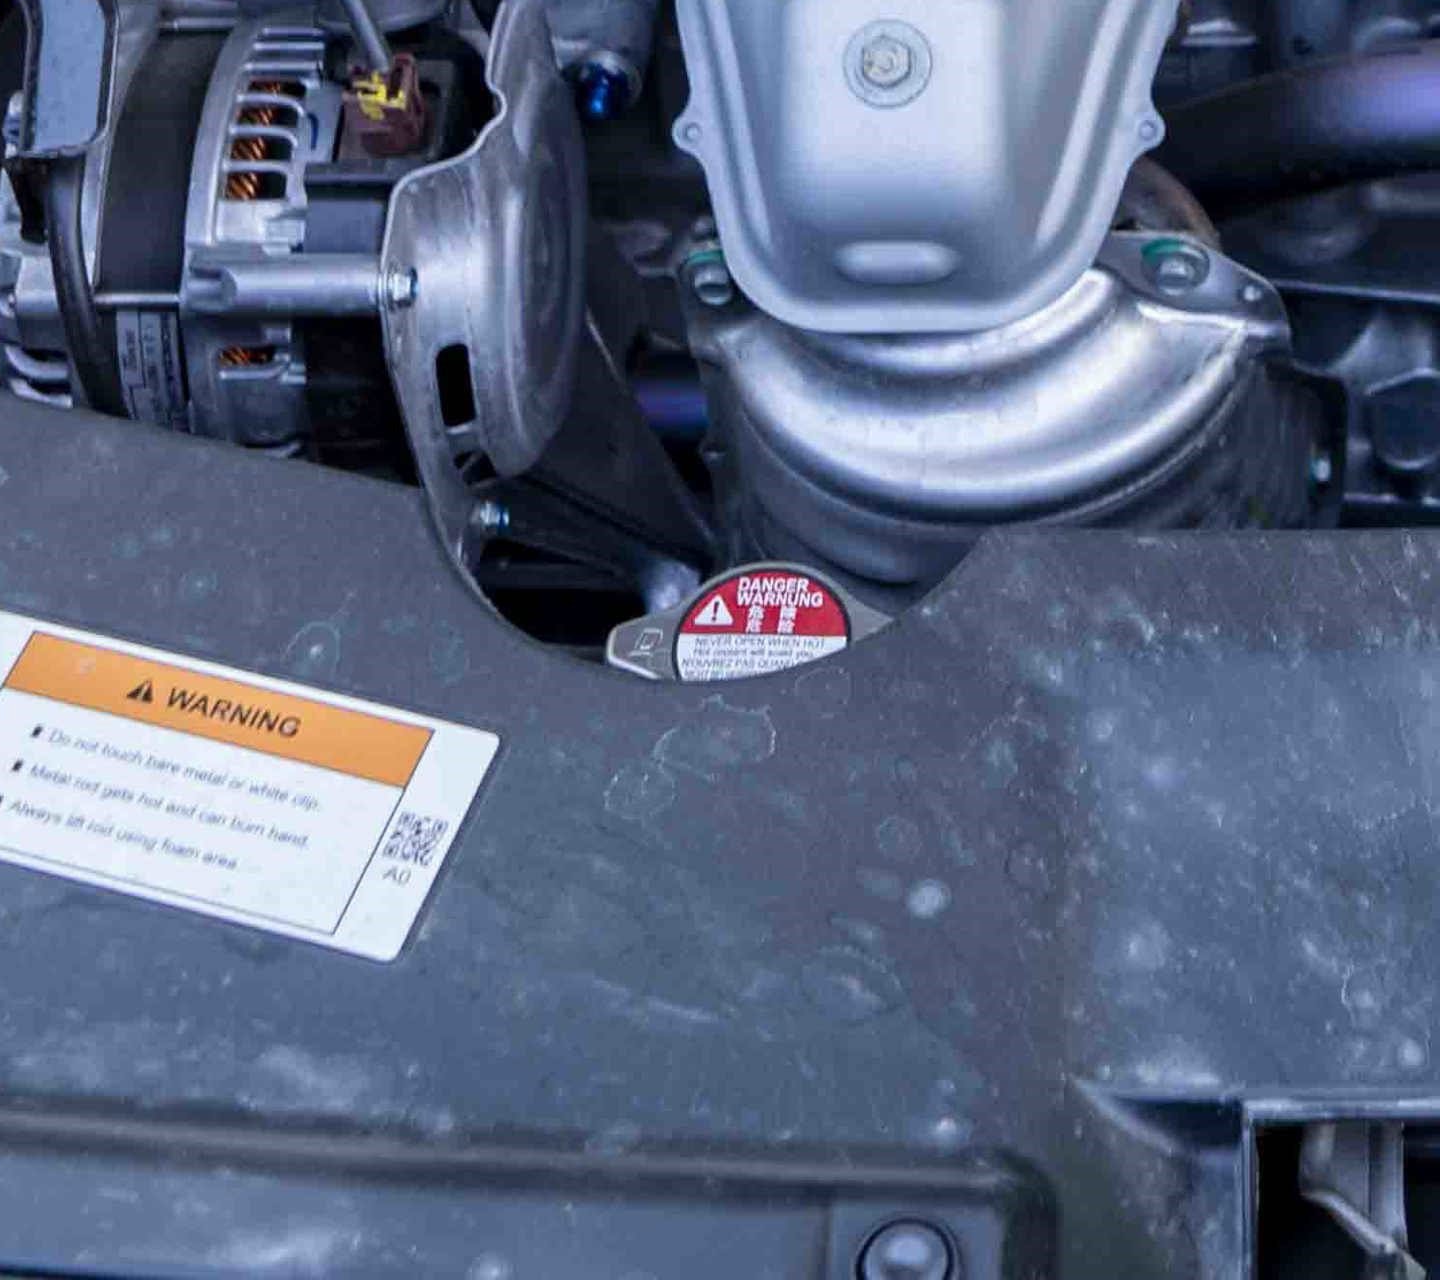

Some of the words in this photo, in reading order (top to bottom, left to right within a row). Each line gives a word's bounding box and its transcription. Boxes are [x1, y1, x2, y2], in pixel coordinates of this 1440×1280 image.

[736, 590, 824, 608] WARNUNG
[738, 576, 810, 592] DANGER
[694, 636, 733, 648] NEVER
[734, 636, 765, 648] OPEN
[767, 637, 799, 649] WHEN
[166, 686, 303, 738] WARNING
[49, 727, 71, 746] Do
[74, 738, 99, 753] not
[101, 743, 144, 765] touch
[145, 752, 182, 774] bare
[183, 765, 229, 787] metal
[228, 777, 247, 790] or
[248, 781, 290, 802] white
[30, 762, 71, 786] Metal
[73, 775, 101, 793] rod
[99, 785, 135, 802] gets
[137, 792, 165, 809] hot
[165, 801, 199, 819] and
[199, 811, 227, 826] can
[229, 815, 266, 836] burn
[10, 799, 62, 824] Always
[65, 813, 85, 829] lift
[87, 817, 115, 838] rod
[116, 828, 158, 851] using
[160, 837, 200, 859] foam
